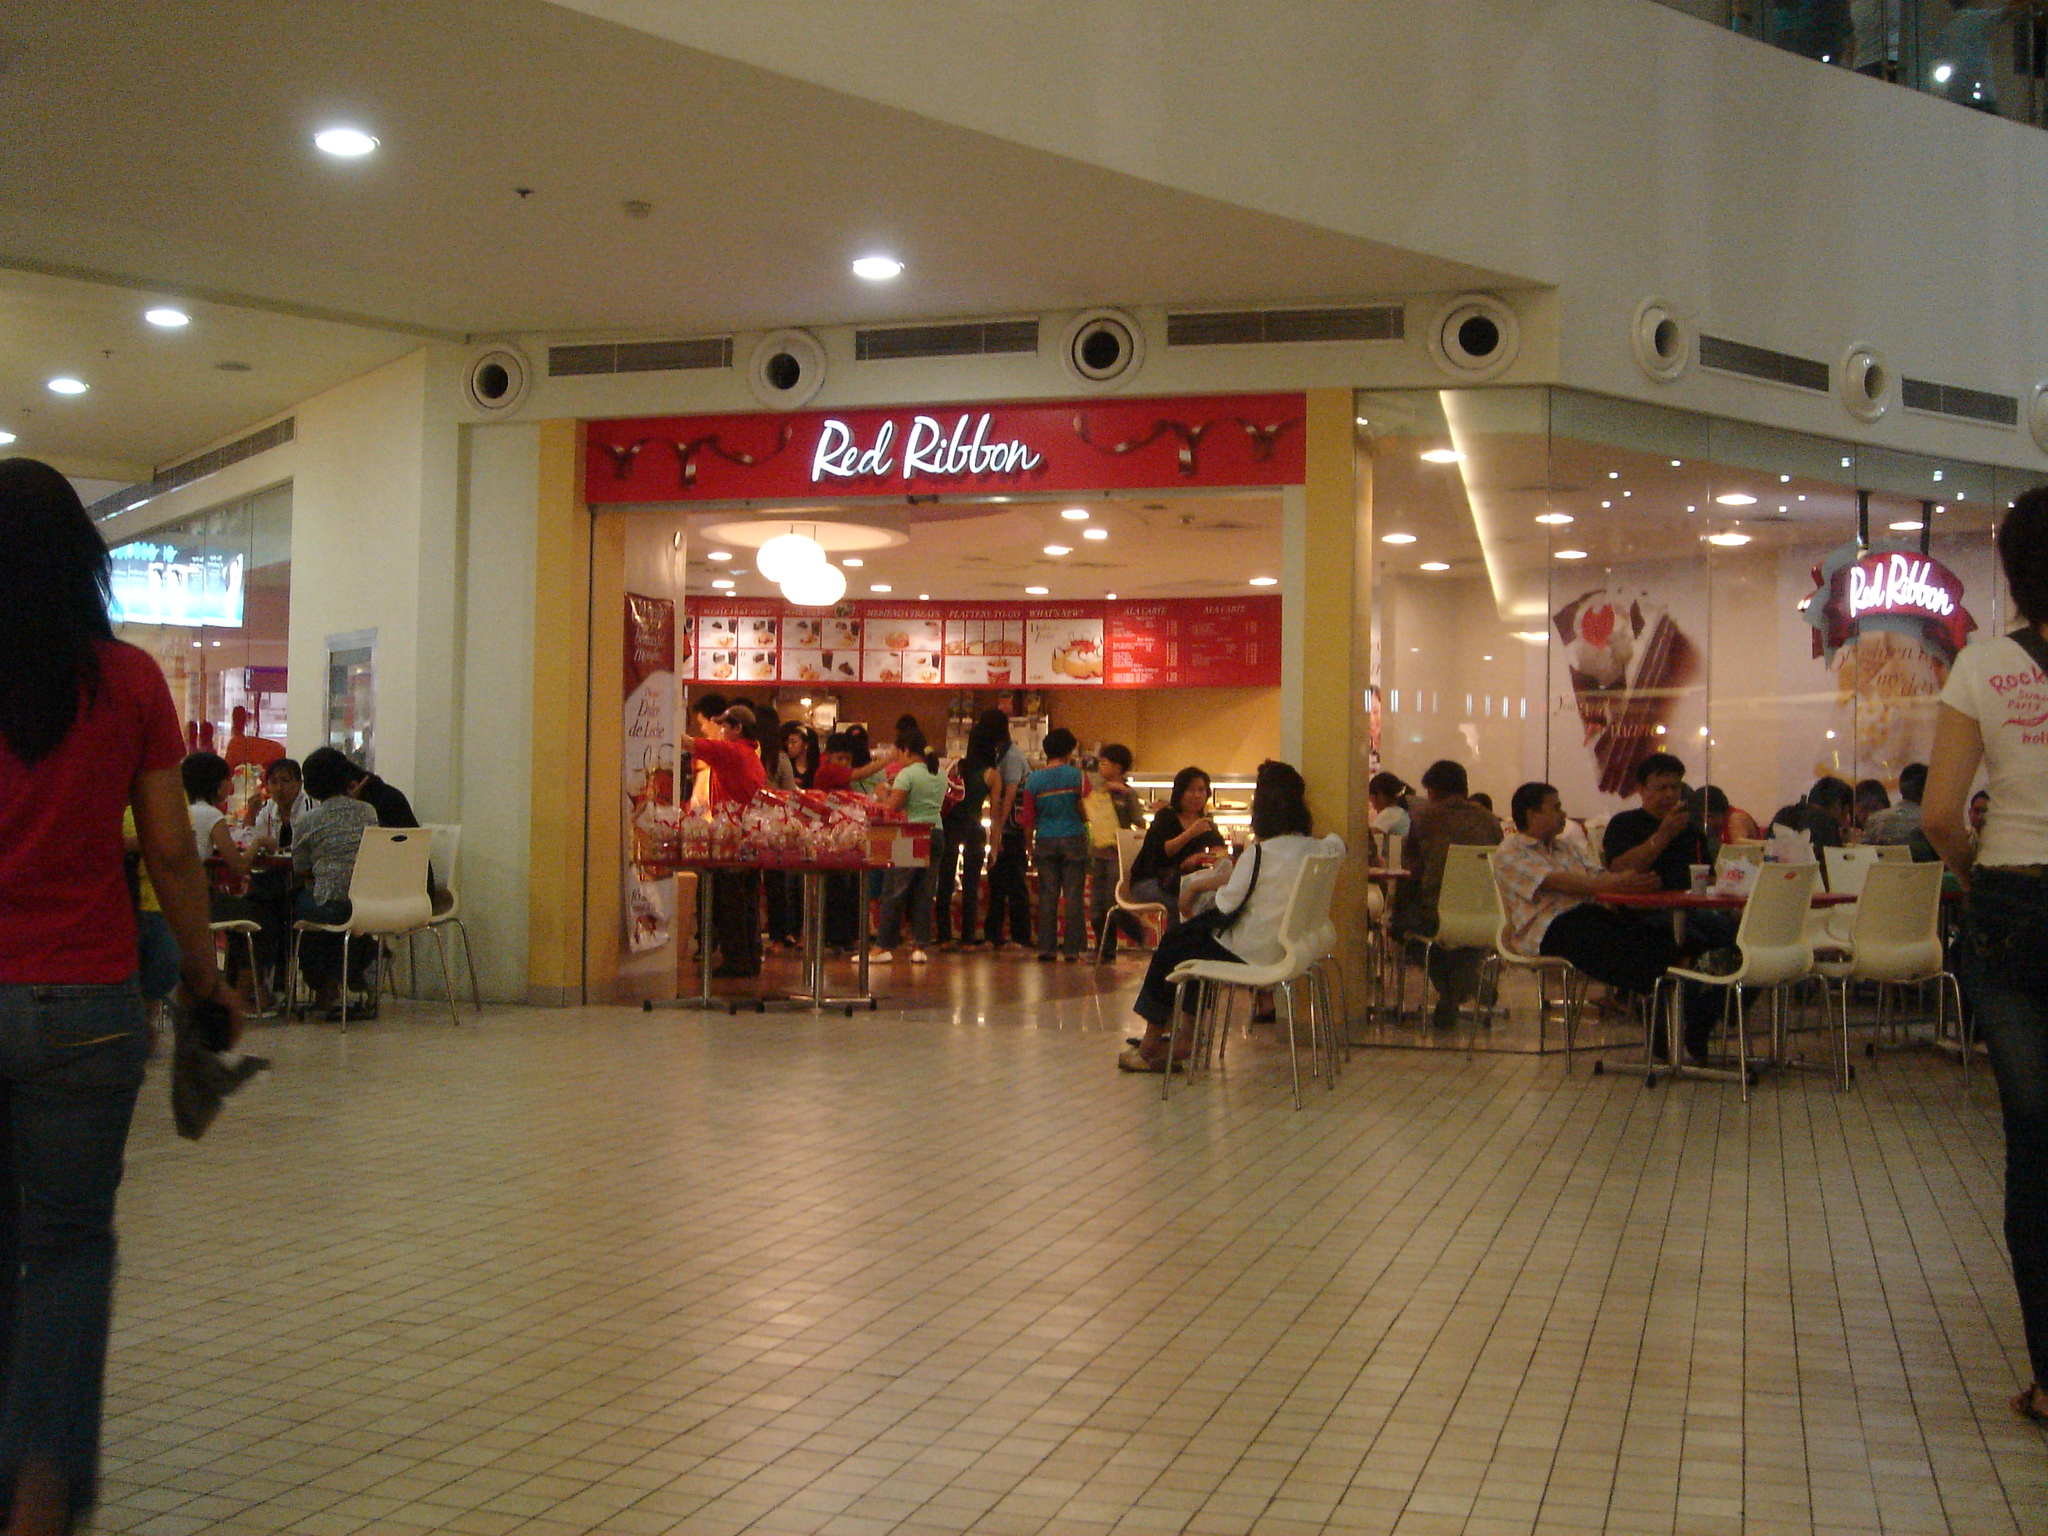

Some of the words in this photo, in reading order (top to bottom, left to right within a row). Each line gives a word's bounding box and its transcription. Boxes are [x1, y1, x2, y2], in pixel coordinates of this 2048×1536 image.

[811, 419, 893, 482] Red
[902, 412, 1041, 480] Ribbon
[1850, 562, 1885, 618] Red
[1885, 553, 1954, 616] Ribbon
